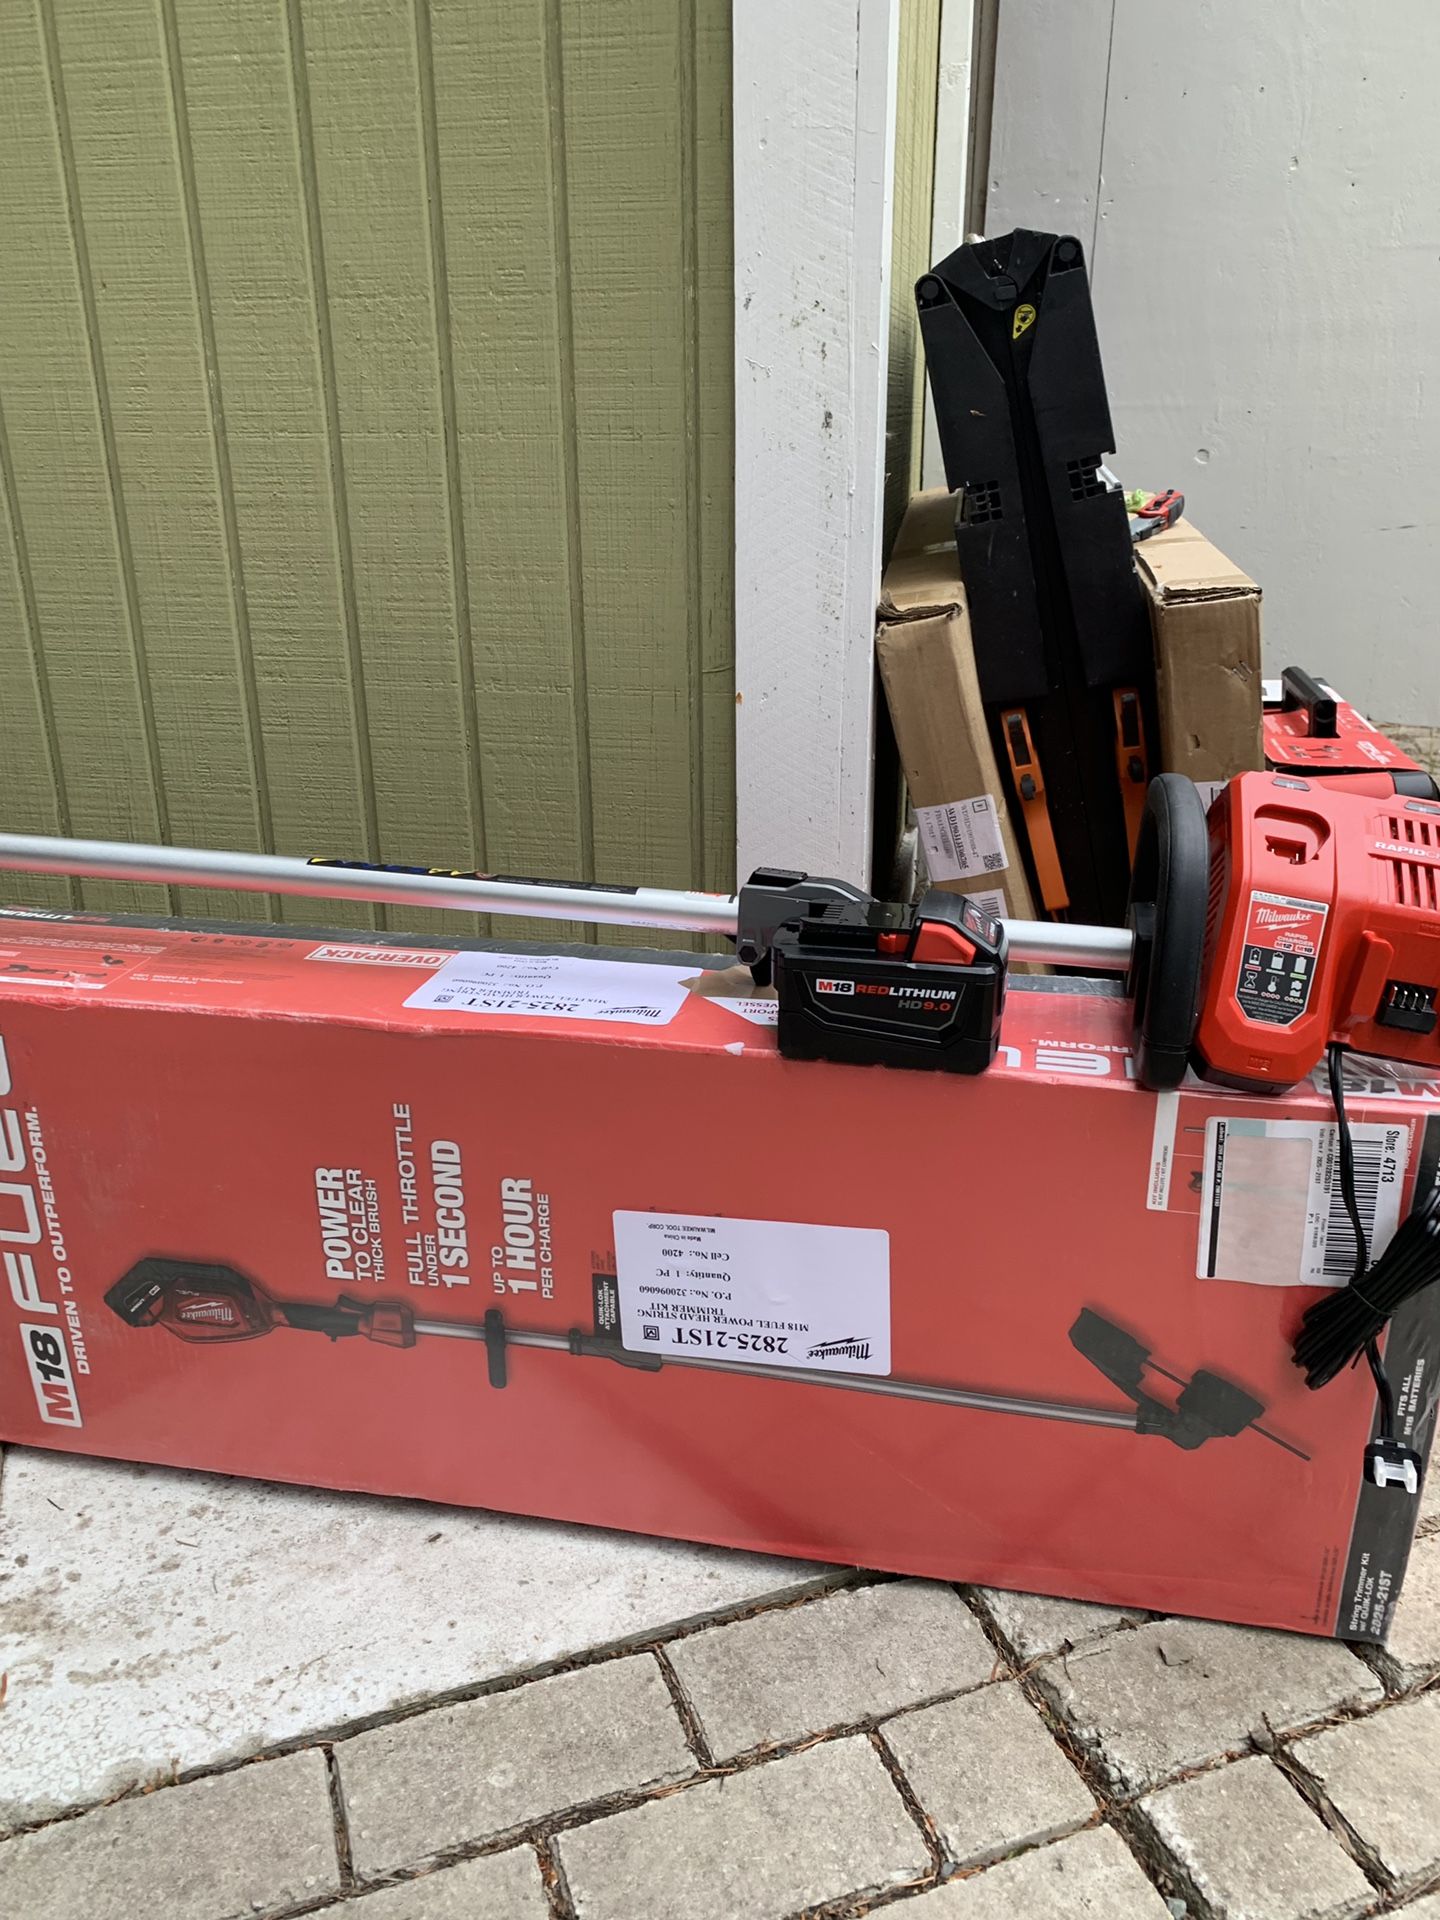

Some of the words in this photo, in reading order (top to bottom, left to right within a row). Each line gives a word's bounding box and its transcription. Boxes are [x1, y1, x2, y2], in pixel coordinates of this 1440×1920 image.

[1255, 907, 1312, 924] Milwaukee
[1277, 936, 1313, 946] CHARGER
[1284, 931, 1308, 940] RAPID
[325, 949, 440, 964] OVERPACK
[1275, 941, 1293, 950] M12
[1295, 945, 1314, 954] M18
[817, 979, 854, 994] M18
[856, 984, 957, 1000] REDLITHIUM
[462, 997, 580, 1013] 2825-21ST
[1328, 1129, 1336, 1146] Carton
[1385, 1130, 1400, 1153] Store:
[392, 1103, 420, 1225] THROTTLE
[1381, 1158, 1396, 1183] 4713
[25, 1106, 67, 1261] OUTPERFORM.
[346, 1168, 369, 1245] CLEAR
[365, 1179, 381, 1233] BRUSH
[430, 1140, 469, 1269] SECOND
[315, 1167, 354, 1280] POWER
[501, 1177, 537, 1271] HOUR
[537, 1193, 552, 1263] CHARGE
[371, 1237, 386, 1282] THICK
[405, 1231, 425, 1286] FULL
[424, 1233, 439, 1287] UNDER
[491, 1246, 503, 1268] TO
[662, 1248, 684, 1258] 4200
[689, 1251, 708, 1260] No.:
[711, 1252, 730, 1261] Cell
[354, 1250, 373, 1281] TO
[656, 1268, 670, 1277] PC
[57, 1267, 74, 1295] TO
[442, 1273, 470, 1288] 1
[493, 1271, 506, 1294] UP
[541, 1266, 554, 1299] PER
[686, 1270, 731, 1282] Quantity:
[507, 1279, 538, 1294] 1
[639, 1285, 687, 1297] 320096060
[690, 1290, 709, 1298] No.:
[712, 1291, 732, 1300] P.O.
[181, 1307, 235, 1322] Milwaukee
[603, 1281, 611, 1331] ATTACHMENT
[637, 1308, 677, 1320] STRING
[650, 1302, 669, 1311] KIT
[671, 1304, 725, 1316] TRIMMER
[680, 1313, 710, 1323] HEAD
[713, 1316, 753, 1327] POWER
[756, 1319, 785, 1330] FUEL
[787, 1323, 809, 1332] M18
[63, 1300, 91, 1375] DRIVEN
[672, 1327, 789, 1354] 2825-21ST
[806, 1342, 874, 1360] Milwaukee
[26, 1326, 79, 1425] M18
[1401, 1374, 1412, 1393] ALL
[1408, 1358, 1425, 1413] BATTERIES
[1397, 1395, 1408, 1417] FITS
[1403, 1416, 1414, 1436] M18
[1361, 1552, 1371, 1566] Kit
[1354, 1566, 1367, 1603] Trimmer
[1349, 1604, 1362, 1631] String
[1360, 1621, 1367, 1632] w/
